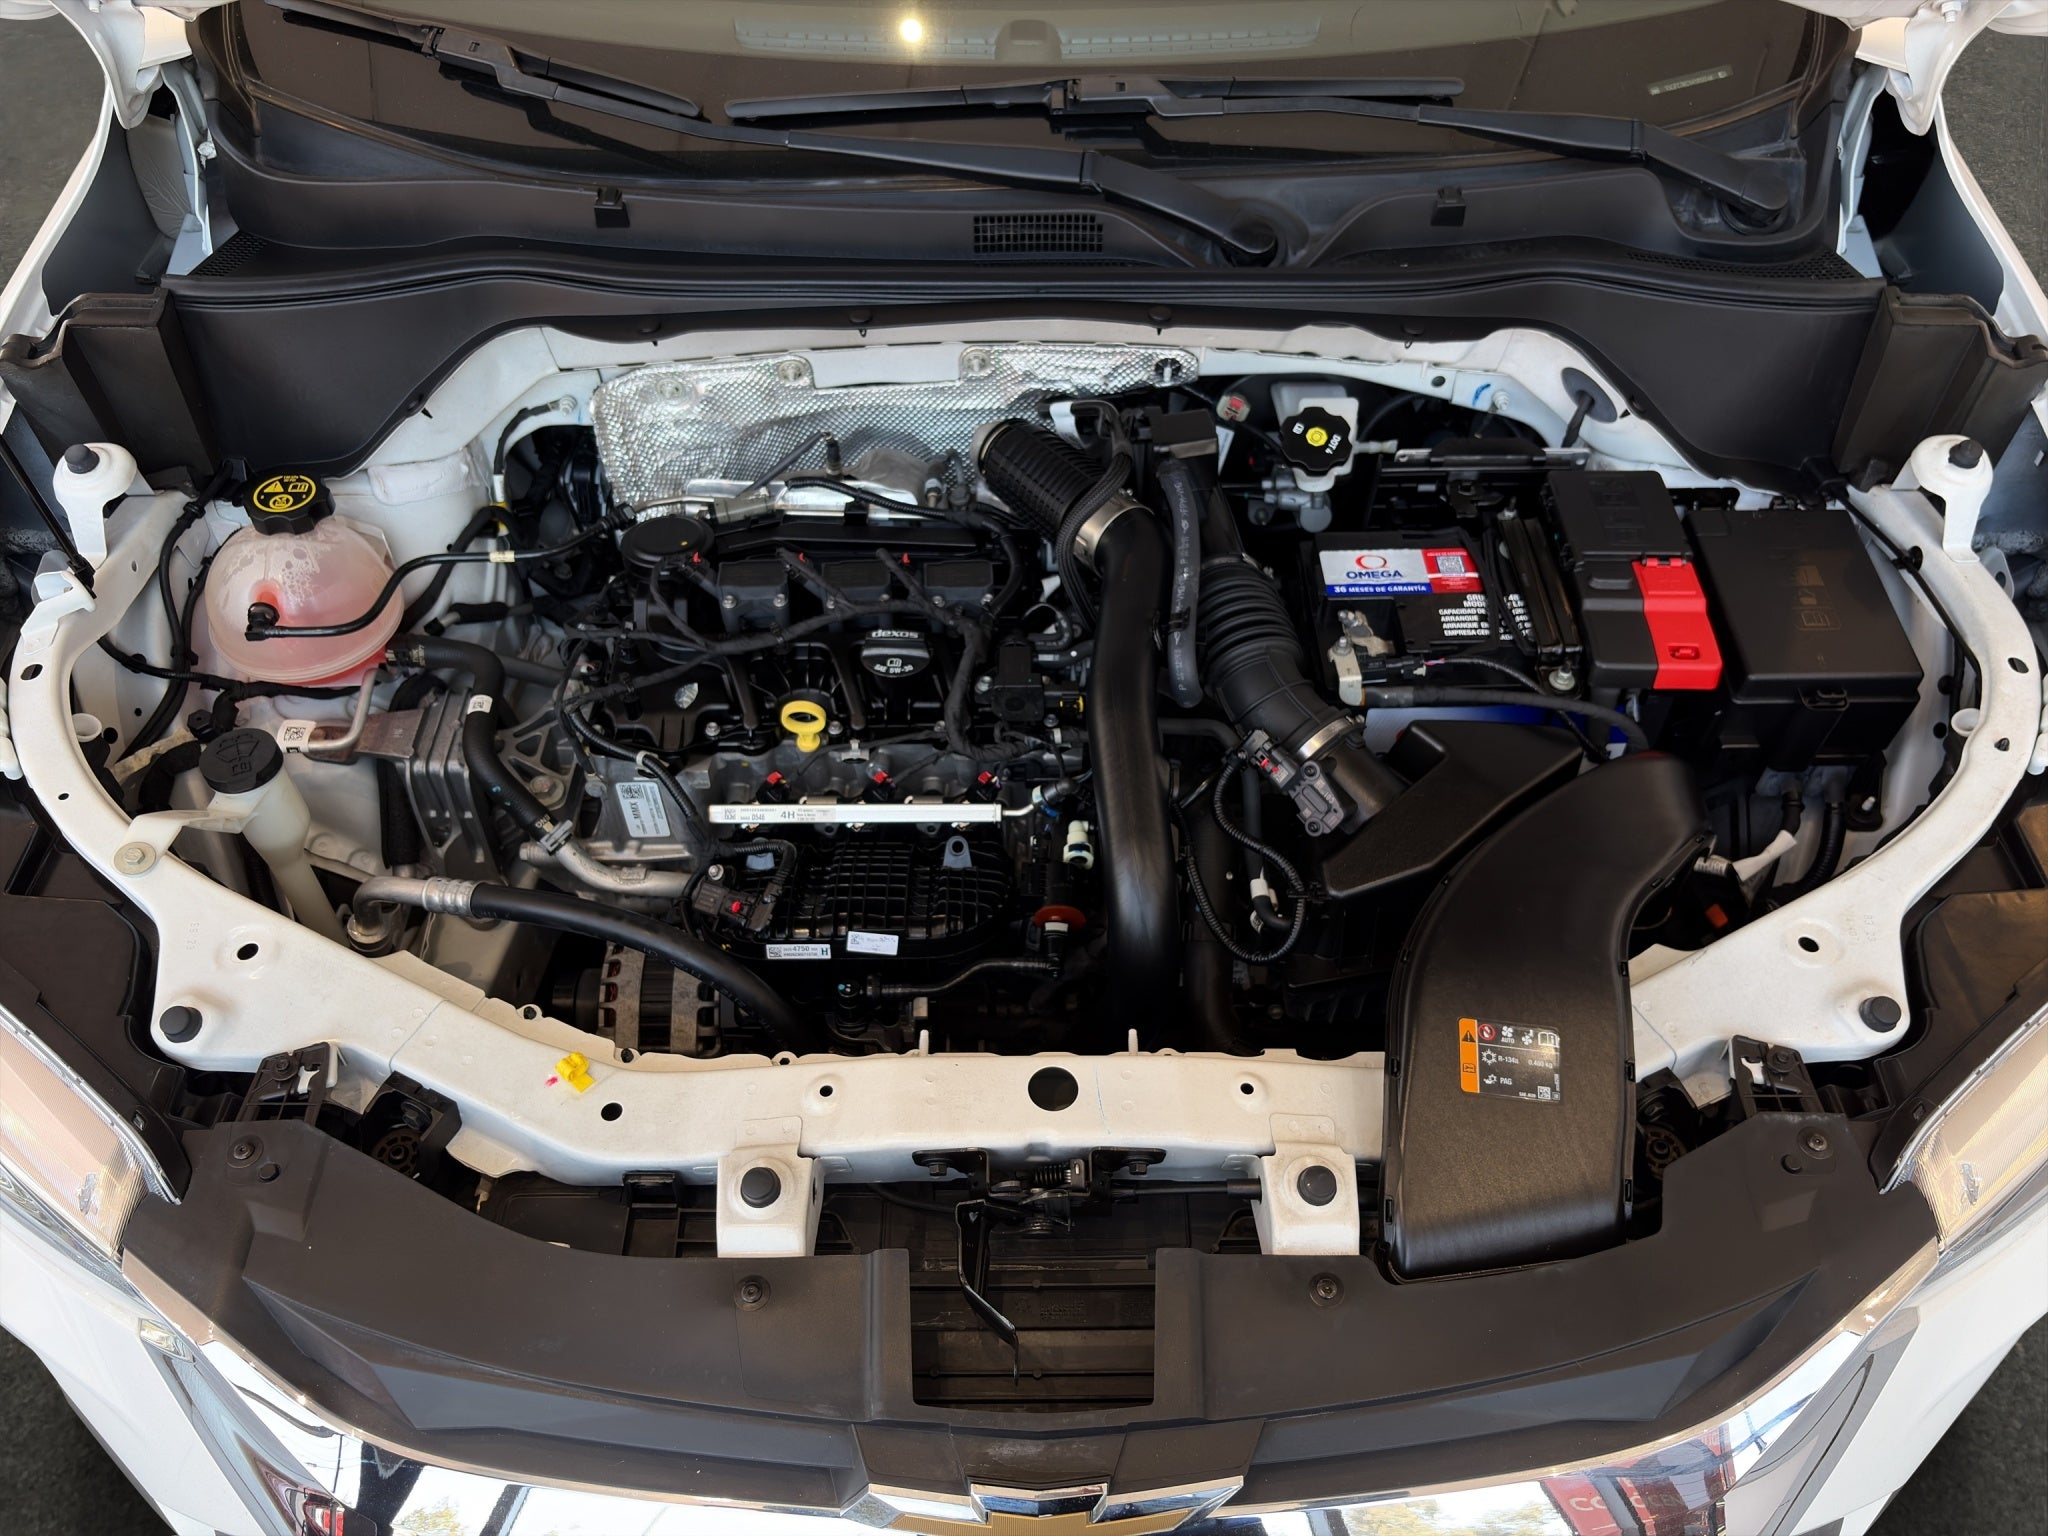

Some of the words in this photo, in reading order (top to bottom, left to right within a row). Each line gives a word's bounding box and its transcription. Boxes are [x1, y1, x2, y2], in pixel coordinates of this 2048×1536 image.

[1328, 434, 1342, 450] DOT
[1345, 570, 1404, 580] OMEGA
[1387, 585, 1427, 593] GARANTÍA
[1443, 621, 1479, 629] ARRANQUE
[871, 629, 919, 639] dexos
[821, 947, 829, 956] H
[1501, 1036, 1515, 1044] AUTO
